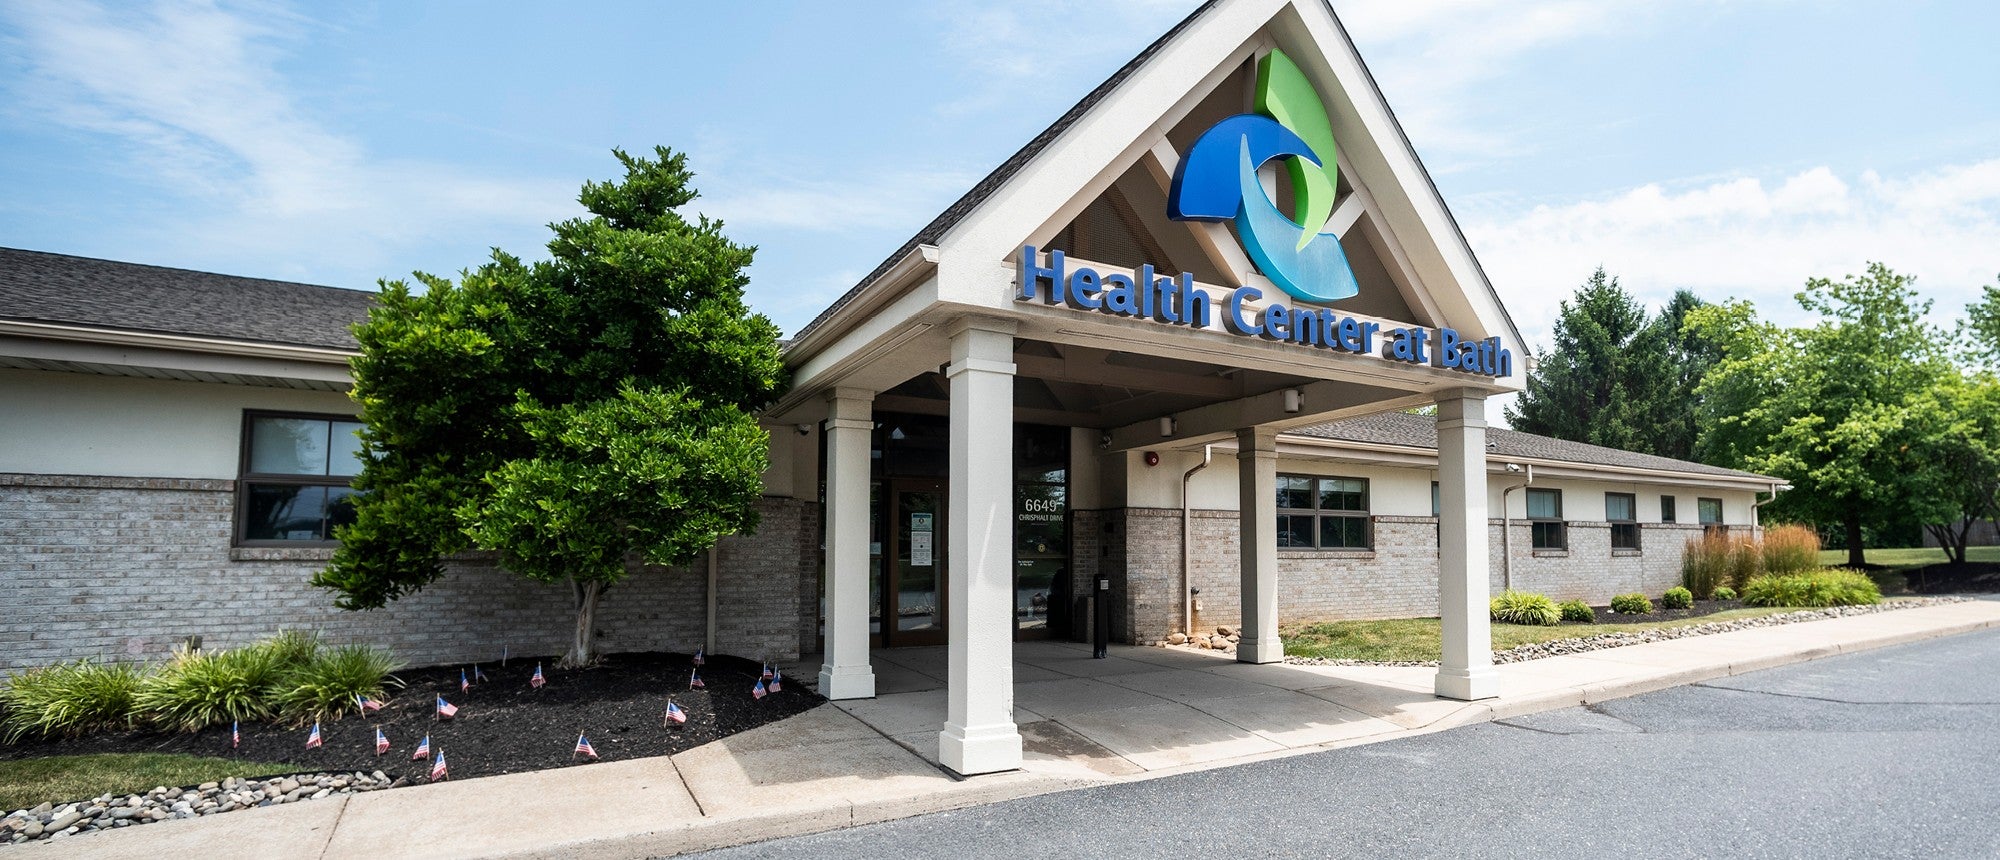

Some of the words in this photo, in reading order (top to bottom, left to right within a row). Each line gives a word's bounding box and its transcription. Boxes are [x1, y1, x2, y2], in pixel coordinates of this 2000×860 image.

[1022, 244, 1211, 327] Health
[1227, 286, 1380, 354] Center
[1390, 326, 1428, 364] at
[1439, 327, 1513, 378] Bath
[1025, 498, 1057, 512] 6649
[1018, 513, 1049, 521] CHRISPHALT
[1050, 514, 1064, 522] DRIVE
